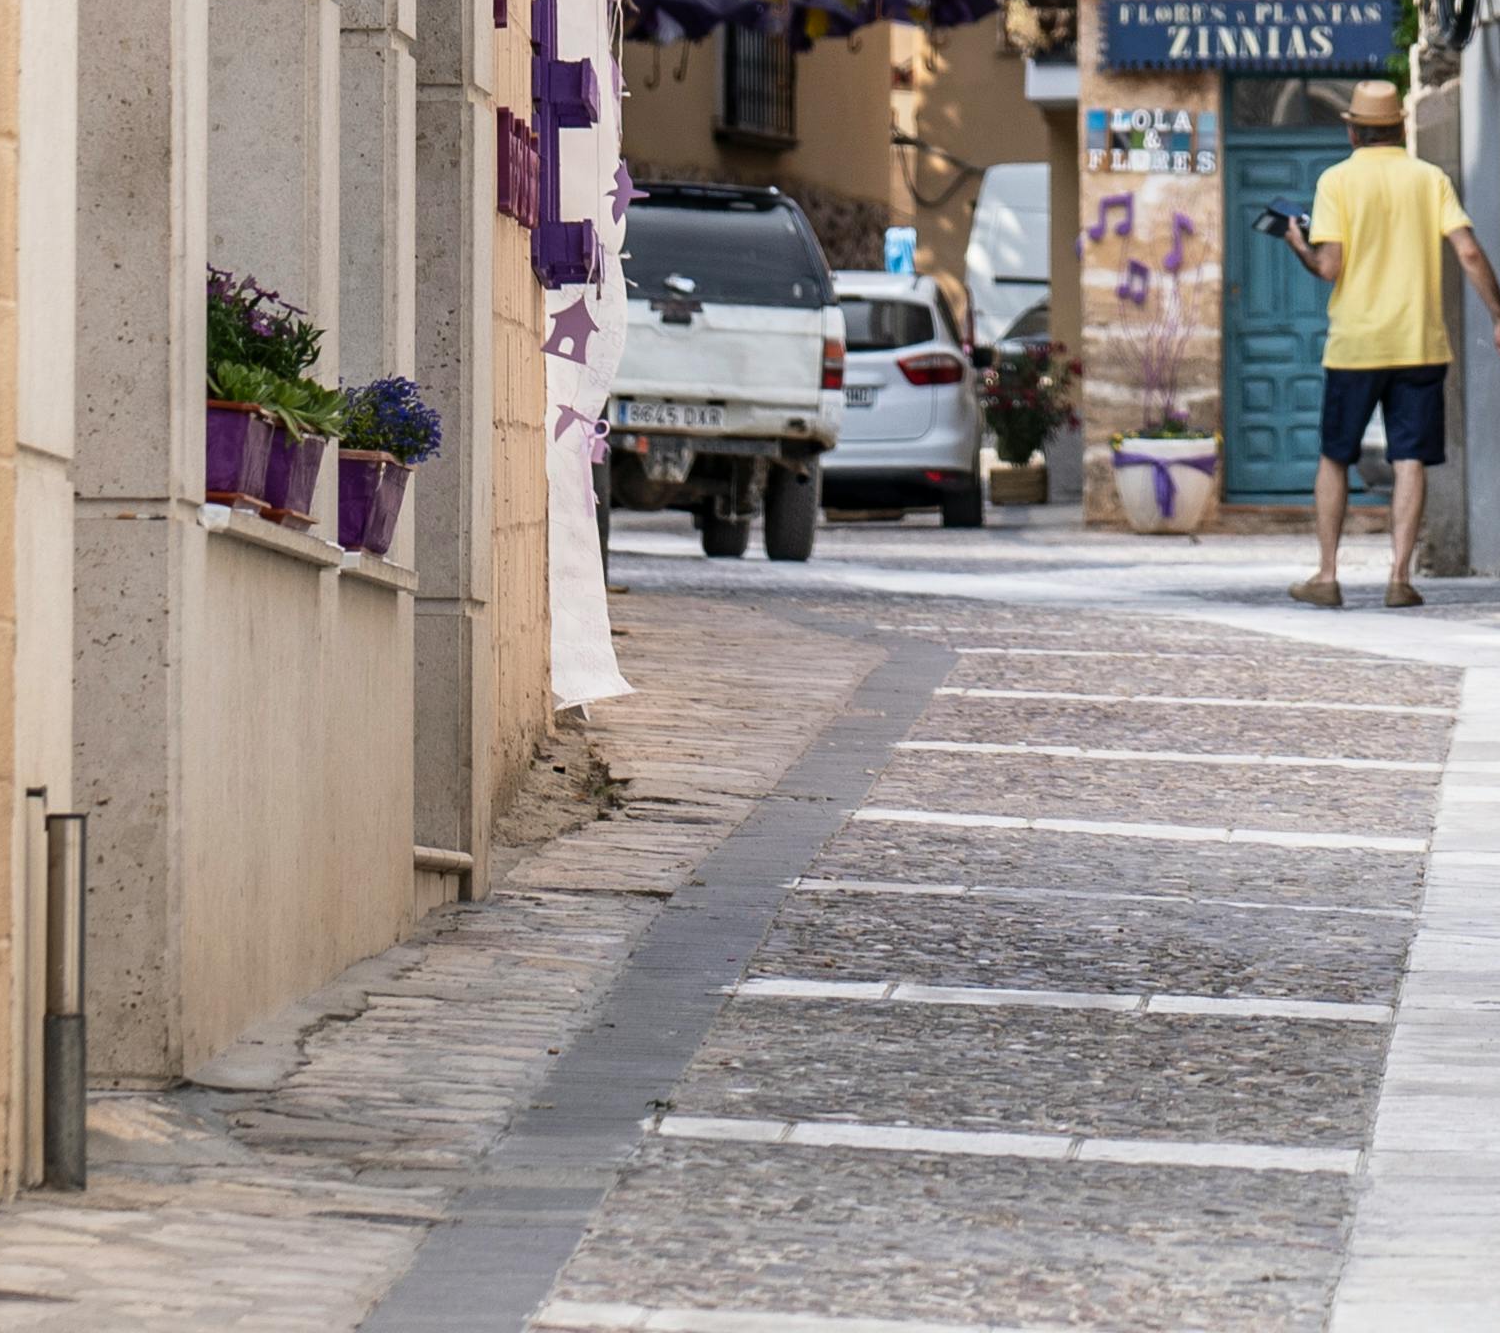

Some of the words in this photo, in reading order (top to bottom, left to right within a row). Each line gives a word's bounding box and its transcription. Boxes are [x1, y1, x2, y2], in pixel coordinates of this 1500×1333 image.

[1118, 1, 1228, 26] FLORES
[1254, 1, 1383, 26] PLANTAS
[1167, 25, 1334, 61] ZINNIAS
[1110, 107, 1193, 133] LOLA
[1142, 128, 1163, 150] &
